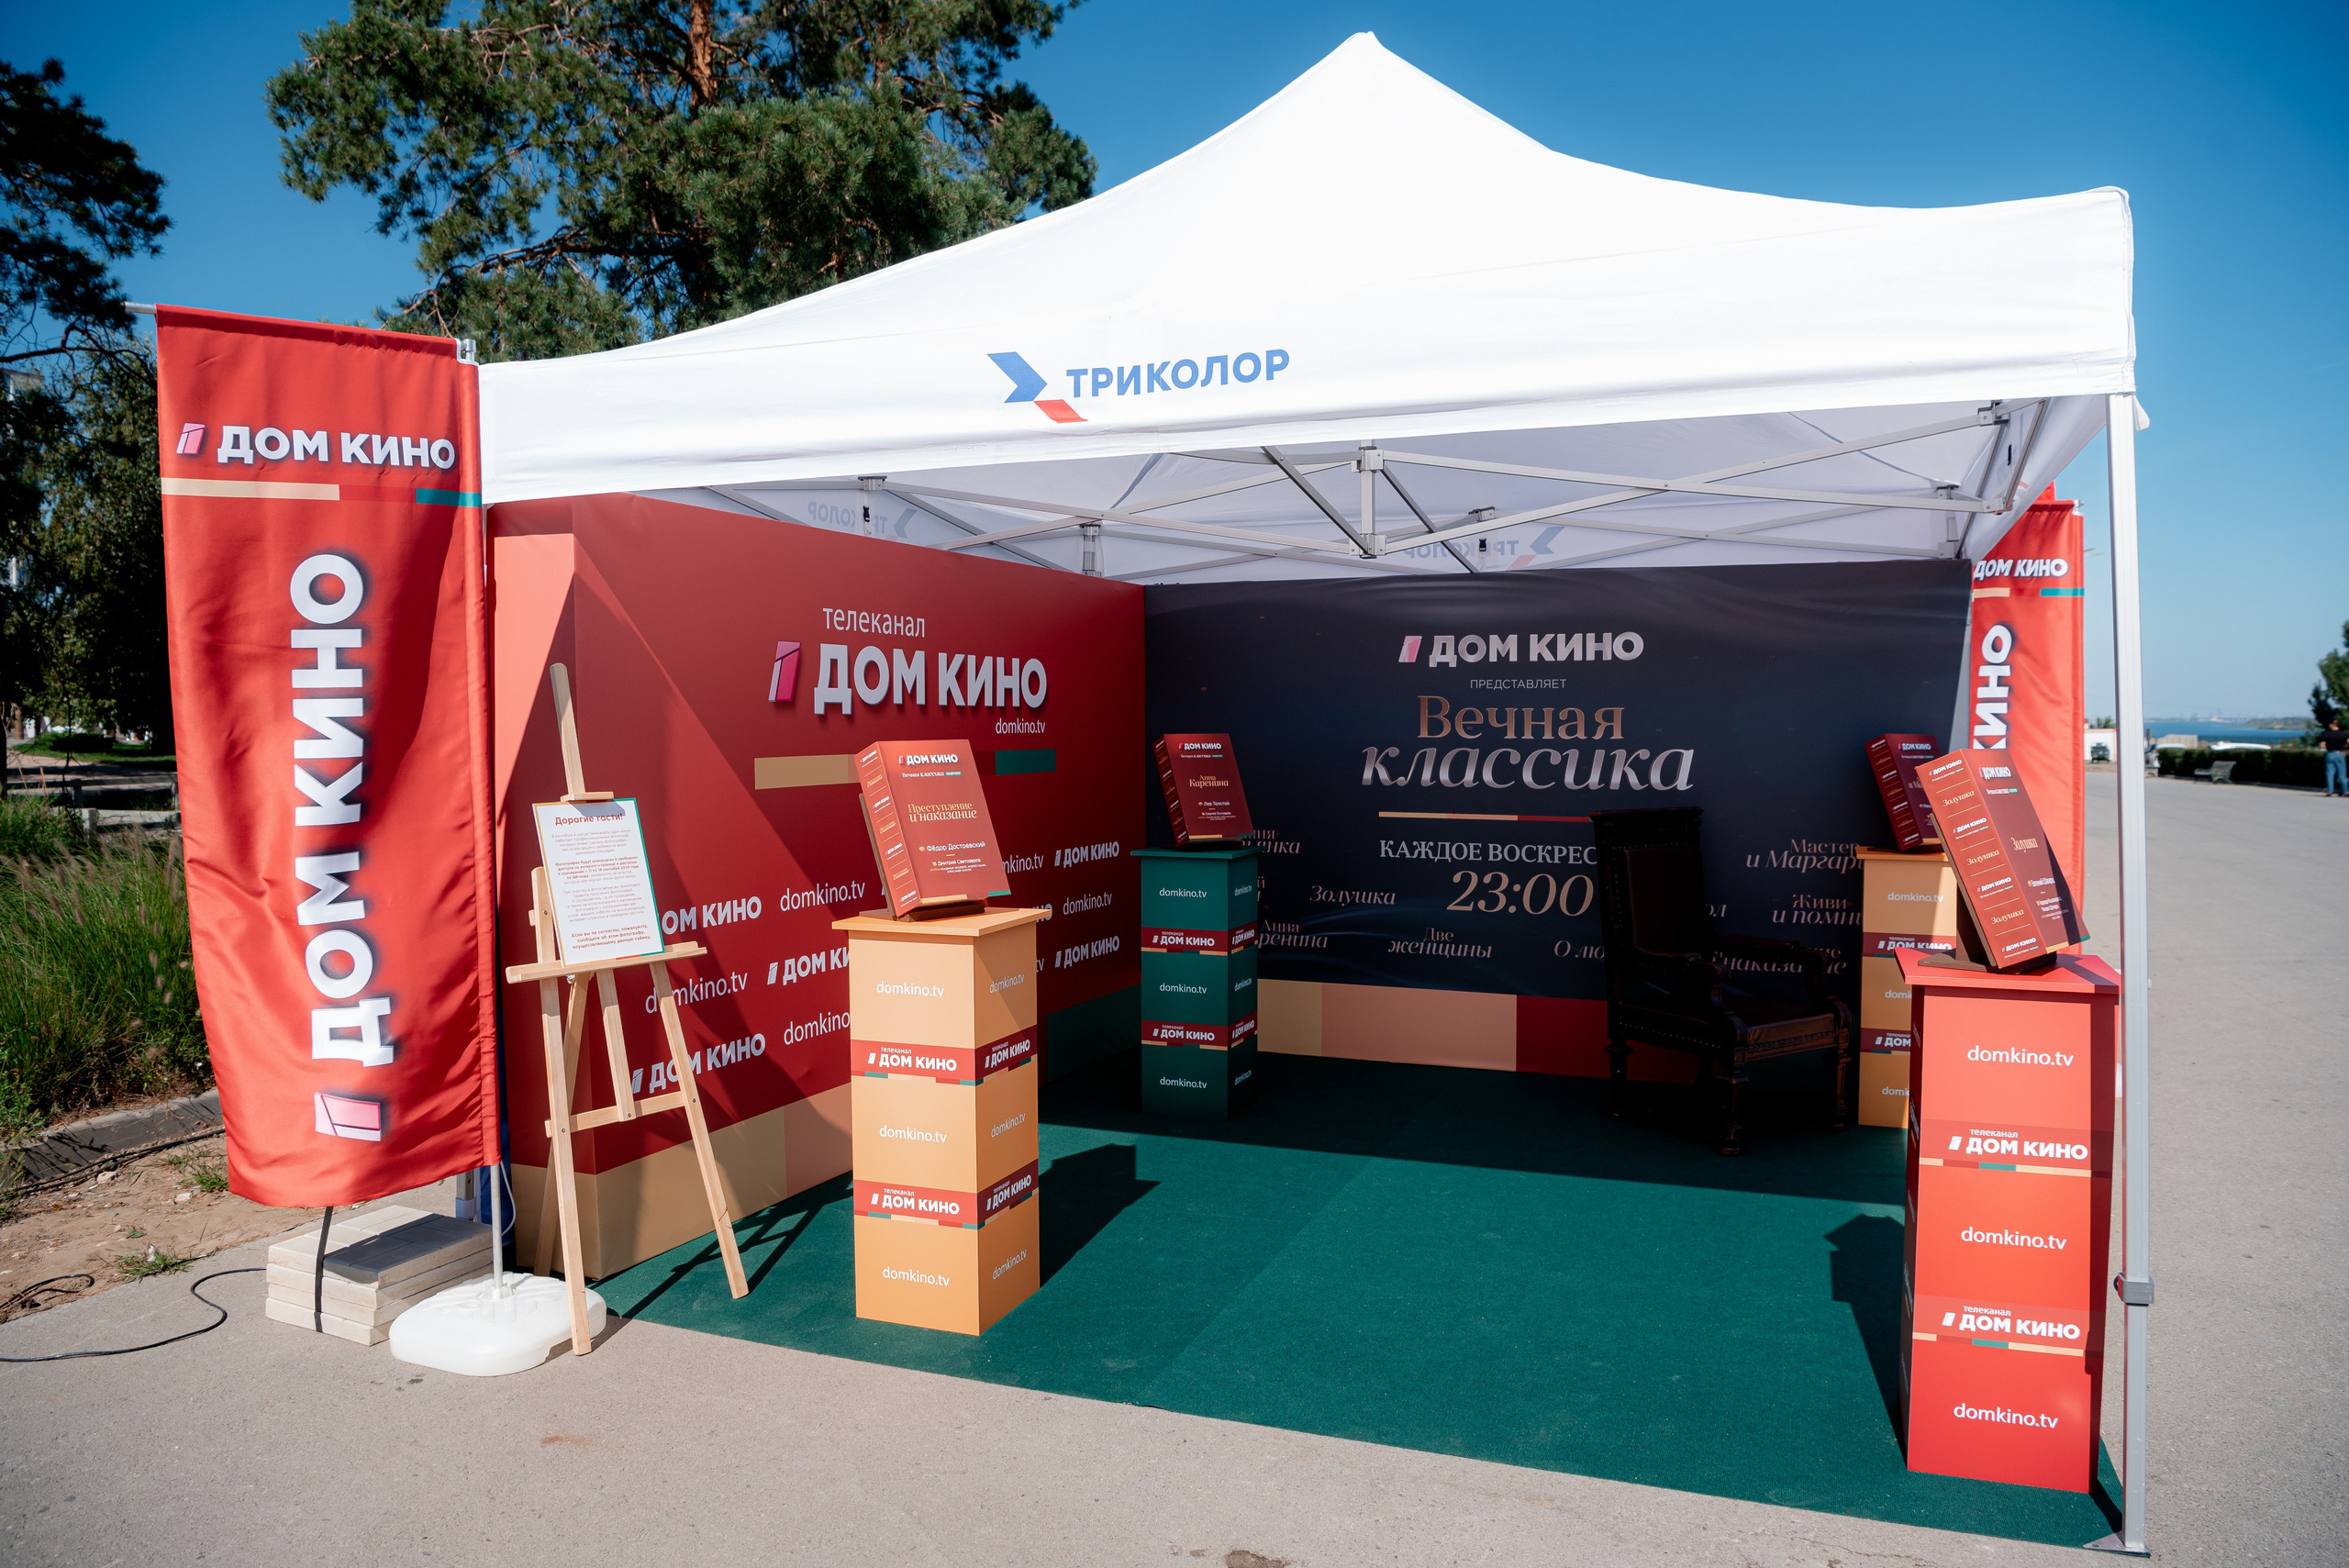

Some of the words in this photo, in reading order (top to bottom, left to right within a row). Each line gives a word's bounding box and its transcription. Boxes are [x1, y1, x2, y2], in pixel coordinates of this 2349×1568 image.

[1066, 349, 1290, 398] ТРИКОЛОР
[217, 424, 328, 464] ДОМ
[341, 432, 456, 472] КИНО
[1974, 559, 2013, 581] ДОМ
[2014, 558, 2068, 577] КИНО
[823, 607, 926, 638] телеканал
[1429, 634, 1518, 668] ДОМ
[1529, 631, 1644, 662] КИНО
[814, 643, 926, 715] ДОМ
[938, 652, 1048, 709] КИНО
[1470, 679, 1567, 690] ПРЕДСТАВЛЯЕТ
[290, 553, 364, 828] КИНО
[996, 717, 1046, 734] domkino.tv
[1417, 695, 1625, 740] Вечная
[1184, 742, 1201, 751] ДОМ
[907, 755, 930, 766] ДОМ
[930, 753, 959, 764] КИНО
[1362, 746, 1695, 791] классика
[1932, 766, 1946, 775] ДОМ
[1945, 759, 1963, 771] КИНО
[1189, 779, 1230, 789] Каренина
[1942, 790, 1975, 807] Золушка
[907, 802, 973, 816] Преступление
[909, 814, 918, 822] и
[918, 808, 977, 822] наказание
[555, 816, 594, 827] Дорогие
[596, 813, 623, 822] гости!
[1956, 824, 1971, 833] ДОМ
[1970, 817, 1987, 828] КИНО
[927, 843, 947, 852] Фёдор
[948, 840, 986, 851] Достоевский
[1063, 846, 1089, 868] ДОМ
[1090, 841, 1119, 861] КИНО
[1379, 840, 1482, 863] КАЖДОЕ
[1487, 842, 1598, 865] ВОСКРЕС
[1790, 839, 1860, 857] Мастер
[1002, 853, 1044, 873] mkino.tv
[1746, 853, 1760, 868] и
[1966, 849, 1999, 866] Золушка
[1160, 887, 1208, 898] domkino.tv
[1446, 870, 1594, 917] 23:00
[1981, 883, 1995, 892] ДОМ
[1995, 876, 2011, 886] КИНО
[780, 881, 865, 912] domkino.tv
[1063, 892, 1112, 915] domkino.tv
[1309, 884, 1397, 908] Золушка
[1792, 894, 1846, 909] Живи
[1887, 892, 1944, 903] domkino.tv
[662, 906, 696, 935] ОМ
[702, 896, 762, 928] КИНО
[1773, 909, 1786, 923] и
[1990, 908, 2024, 925] Золушка
[1260, 918, 1300, 934] Анна
[1423, 927, 1454, 943] Две
[1160, 936, 1184, 946] ДОМ
[1186, 937, 1215, 947] КИНО
[1258, 931, 1329, 951] ренина
[1387, 940, 1493, 960] женщины
[1553, 940, 1571, 959] О
[1887, 940, 1915, 951] ДОМ
[2006, 943, 2020, 952] ДОМ
[2020, 937, 2037, 947] КИНО
[297, 852, 395, 1068] ДОМ
[1063, 943, 1089, 969] ДОМ
[1091, 935, 1119, 958] КИНО
[783, 951, 826, 985] ДОМ
[645, 972, 748, 1014] dmkino.tv
[876, 981, 944, 997] domkino.tv
[989, 973, 1025, 994] domkino.tv
[1160, 983, 1207, 995] domkino.tv
[784, 1011, 851, 1045] domkino
[1160, 1029, 1184, 1040] ДОМ
[1186, 1030, 1215, 1041] КИНО
[881, 1046, 911, 1054] телеканал
[1885, 1037, 1911, 1047] ДОМ
[707, 1033, 766, 1072] КИНО
[990, 1050, 1008, 1069] ДОМ
[1009, 1039, 1030, 1059] КИНО
[1967, 1045, 2074, 1066] domkino.tv
[879, 1053, 912, 1068] ДОМ
[915, 1057, 957, 1072] КИНО
[1160, 1077, 1208, 1089] domkino.tv
[879, 1125, 947, 1143] domkino.tv
[991, 1112, 1026, 1138] domkino.tv
[1970, 1129, 2018, 1139] телеканал
[1965, 1138, 2018, 1155] ДОМ
[2023, 1140, 2088, 1160] КИНО
[884, 1187, 915, 1196] телеканал
[992, 1191, 1009, 1209] ДОМ
[1010, 1174, 1031, 1195] КИНО
[882, 1195, 915, 1209] ДОМ
[918, 1198, 960, 1215] КИНО
[1961, 1227, 2066, 1250] domkino.tv
[992, 1249, 1027, 1280] domkino.tv
[882, 1266, 950, 1286] domkino.tv
[1963, 1306, 2011, 1316] телеканал
[1959, 1314, 2010, 1332] ДОМ
[2016, 1319, 2080, 1340] КИНО
[1954, 1403, 2058, 1429] domkino.tv
